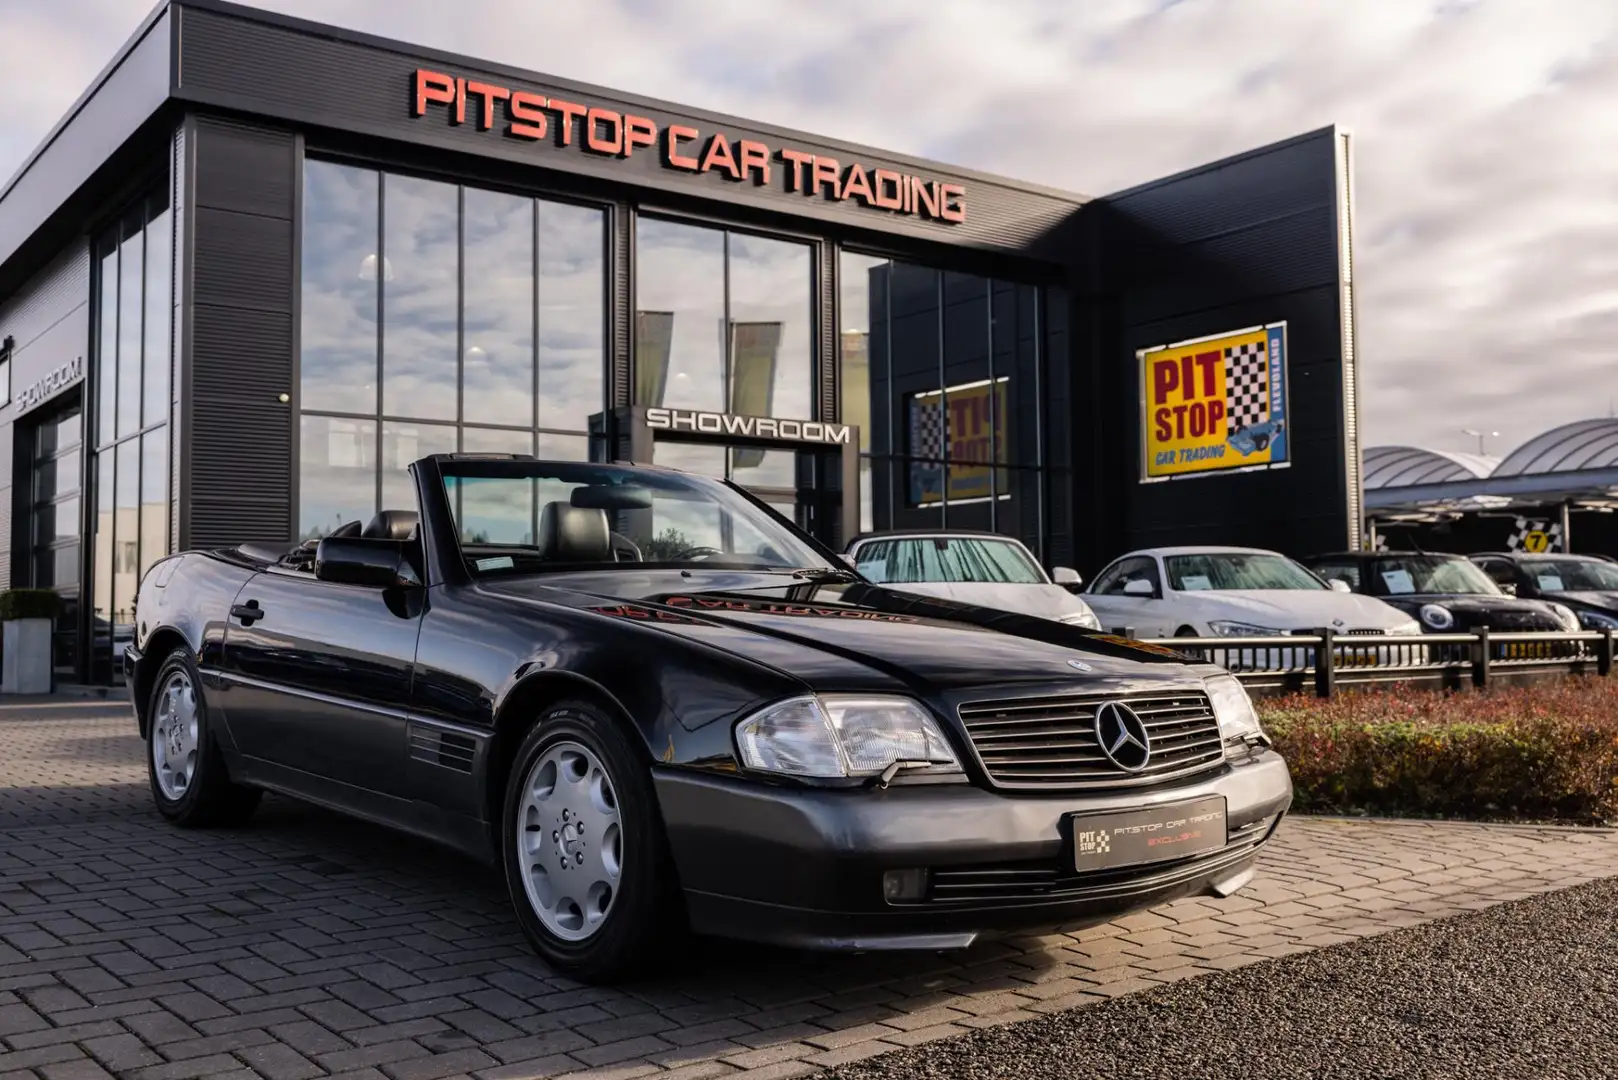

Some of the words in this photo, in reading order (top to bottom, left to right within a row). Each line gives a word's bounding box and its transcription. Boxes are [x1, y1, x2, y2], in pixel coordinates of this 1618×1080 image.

[415, 69, 657, 158] PITSTOP
[668, 125, 771, 186] CAR
[780, 147, 966, 224] TRADING
[1154, 350, 1222, 405] PIT
[1271, 338, 1281, 413] FLEVOLAND
[646, 408, 850, 444] SHOWROOM
[1155, 400, 1224, 443] STOP
[1156, 449, 1176, 466] CAR
[1179, 444, 1226, 463] TRADING
[1530, 535, 1542, 549] 7
[1080, 831, 1095, 843] PIT
[1114, 822, 1163, 836] PITSTOP
[1166, 819, 1187, 829] CAR
[1080, 841, 1096, 851] STOP
